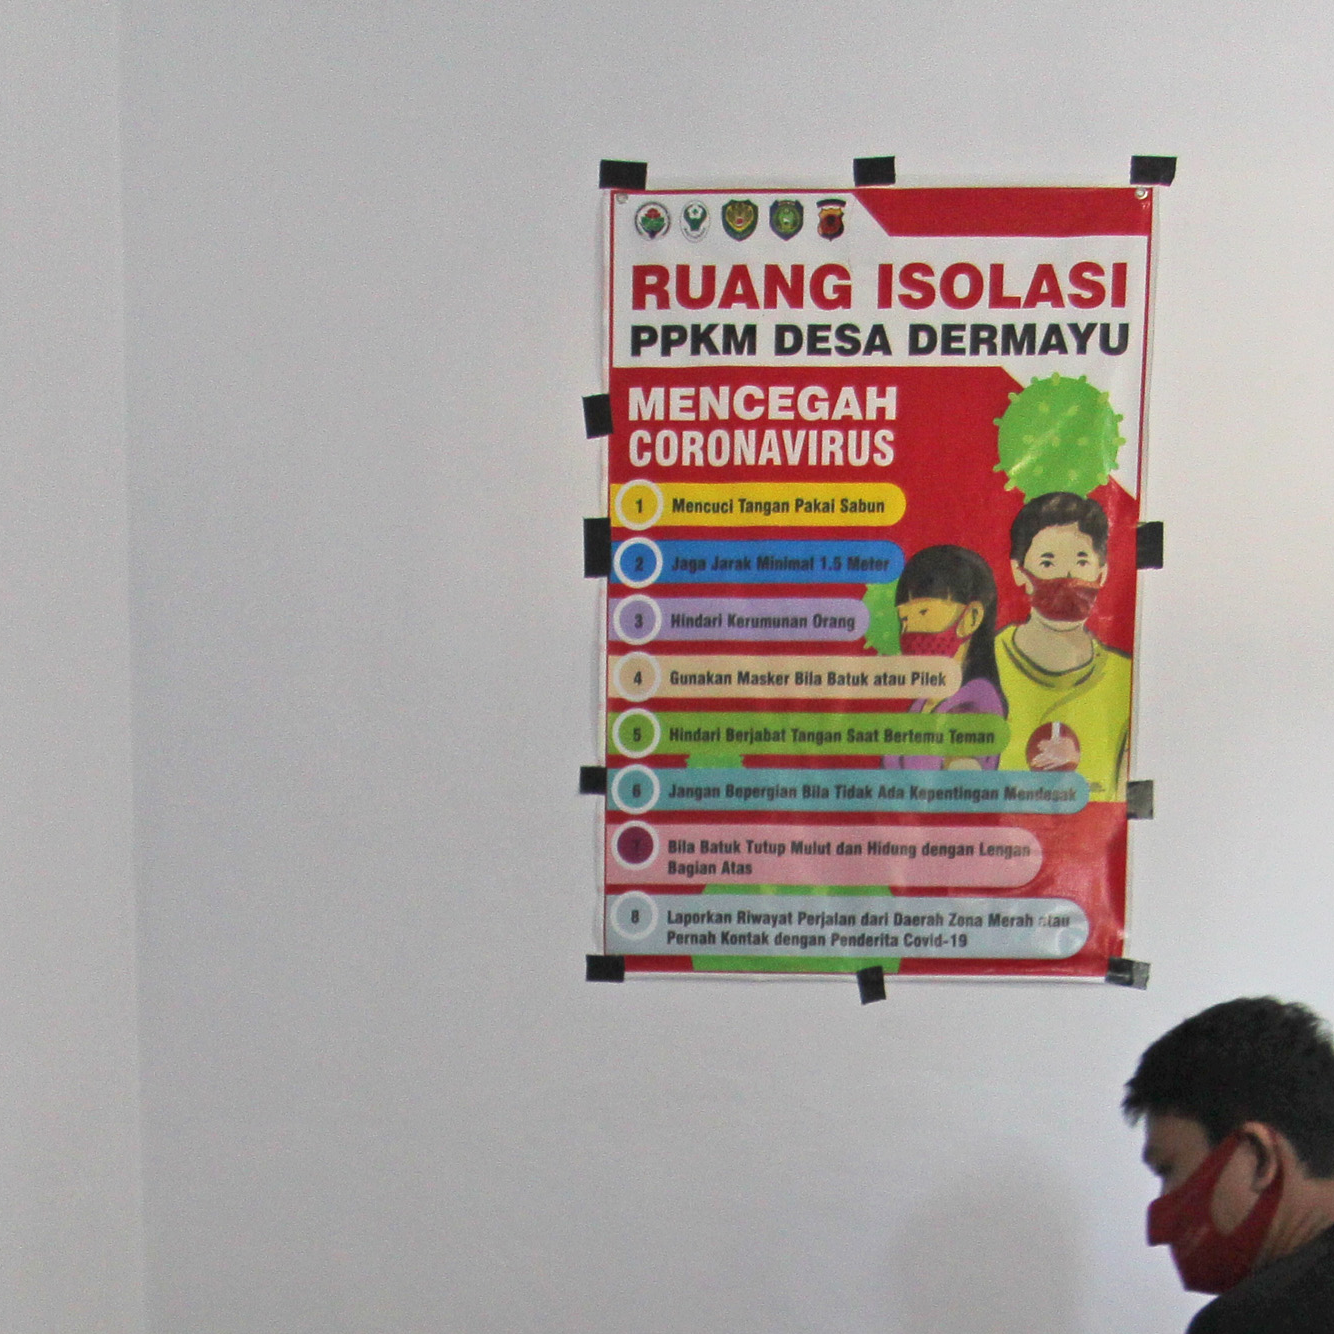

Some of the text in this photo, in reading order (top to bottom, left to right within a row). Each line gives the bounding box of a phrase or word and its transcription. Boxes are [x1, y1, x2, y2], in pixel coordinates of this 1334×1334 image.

[631, 260, 1129, 312] RUANG ISOLASI
[630, 321, 1130, 358] PPKM DESA DERMAYU
[627, 384, 898, 422] MENCEGAH
[628, 428, 896, 468] CORONAVIRUS
[635, 496, 886, 517] 1 Mencuci Tangan Pakai Sabun
[634, 556, 890, 574] 2 Jaga Jarak Minimal 1.5 Meter
[633, 612, 856, 631] 3 Hindari Kerumunan Orang
[633, 670, 947, 687] 4 Gunakan Masker Bila Batuk atau Pilek
[632, 727, 996, 746] 5 Hindari Berjabat Tangan Saat Bertemu Teman
[632, 783, 641, 798] 6
[669, 783, 721, 801] Jangan
[801, 784, 830, 799] Bila
[833, 784, 876, 800] Tidak
[878, 785, 906, 800] Ada
[909, 785, 1000, 804] Kepentingan
[1003, 785, 1078, 802] Mendesak
[668, 840, 696, 855] Bila
[699, 840, 741, 855] Batuk
[745, 840, 786, 857] Tutup
[790, 841, 832, 856] Mulut
[835, 842, 863, 857] dan
[867, 842, 917, 859] Hidung
[921, 842, 975, 860] dengan
[978, 842, 1031, 860] Lengan
[667, 861, 753, 878] Bagian Atas
[630, 909, 640, 924] 8
[667, 910, 733, 928] Laporkan
[736, 911, 793, 929] Riwayat
[797, 911, 856, 929] Perjalan
[860, 912, 889, 928] dari
[892, 912, 945, 928] Daerah
[948, 913, 984, 928] Zona
[987, 913, 1034, 929] Merah
[666, 930, 968, 950] Pernah Kontak dengan Penderita Covid-19
